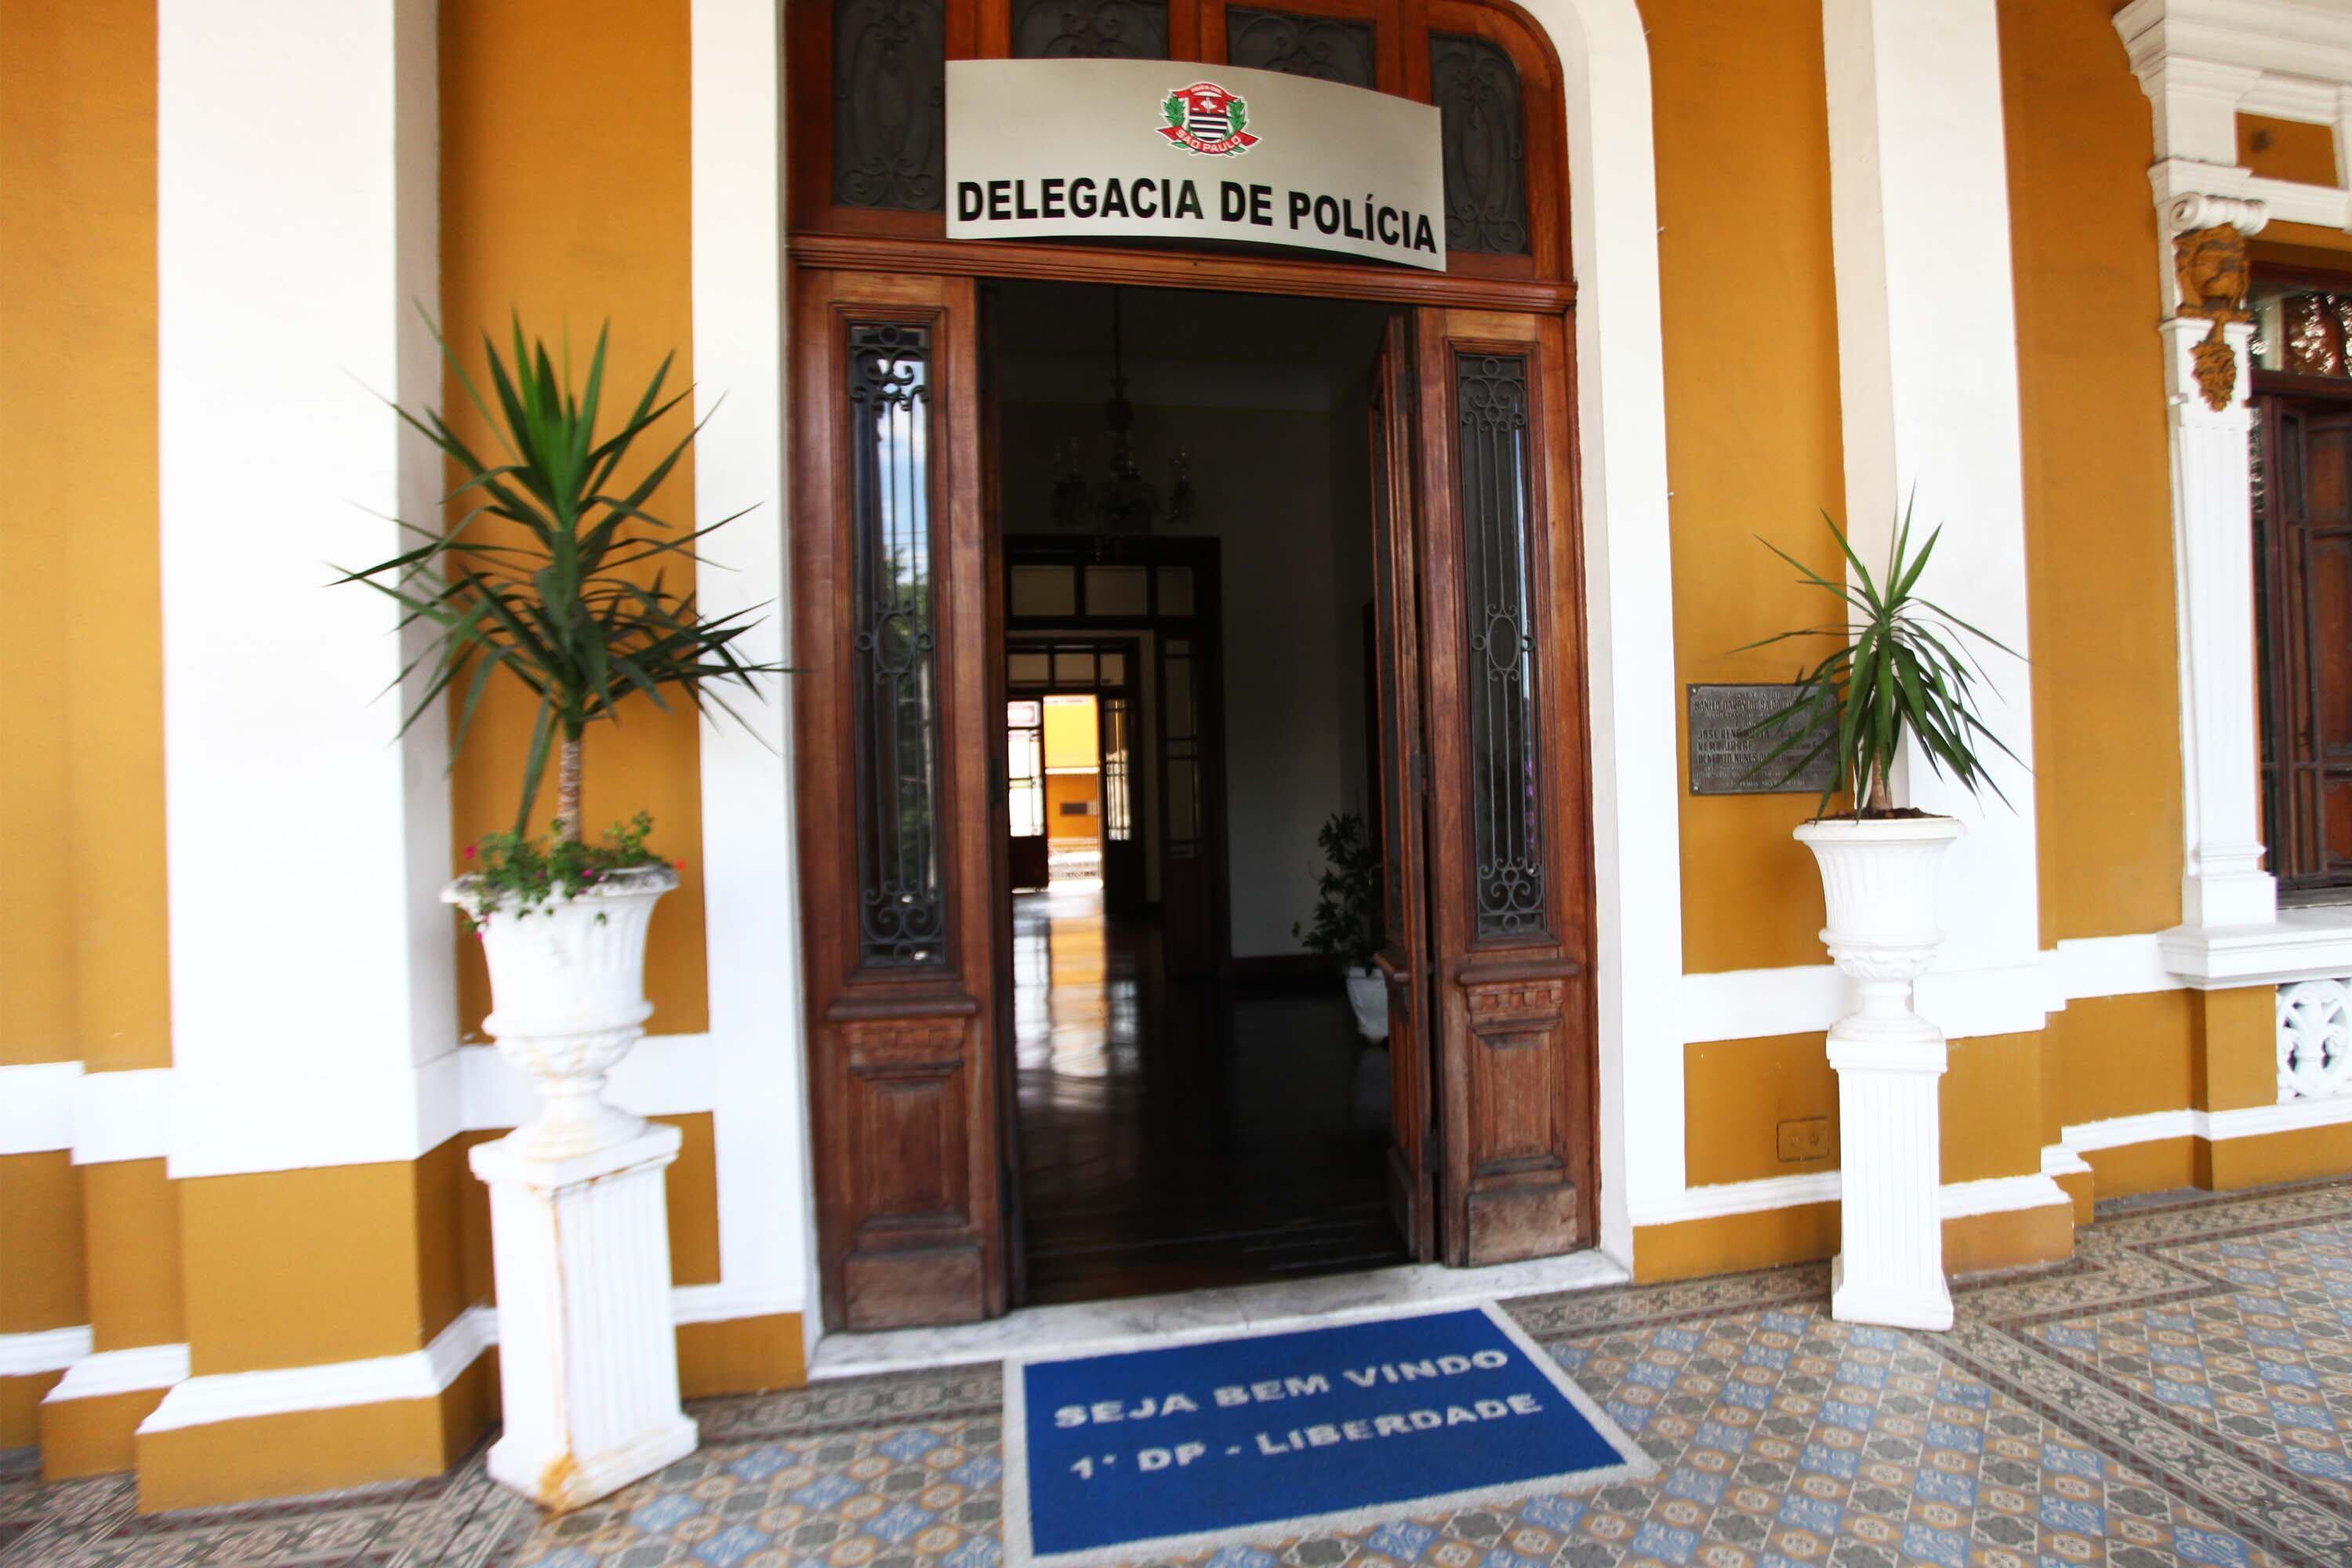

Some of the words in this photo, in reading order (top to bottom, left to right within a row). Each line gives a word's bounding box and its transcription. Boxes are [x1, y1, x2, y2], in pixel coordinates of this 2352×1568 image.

[1203, 135, 1241, 152] PAULO
[956, 177, 1205, 222] DELEGACIA
[1220, 180, 1273, 227] DE
[1287, 191, 1438, 254] POLÍCIA
[1054, 1394, 1199, 1428] SEJA
[1214, 1375, 1330, 1407] BEM
[1343, 1350, 1509, 1388] VINDO
[1138, 1441, 1207, 1472] DP
[1256, 1394, 1543, 1455] LIBERDADE
